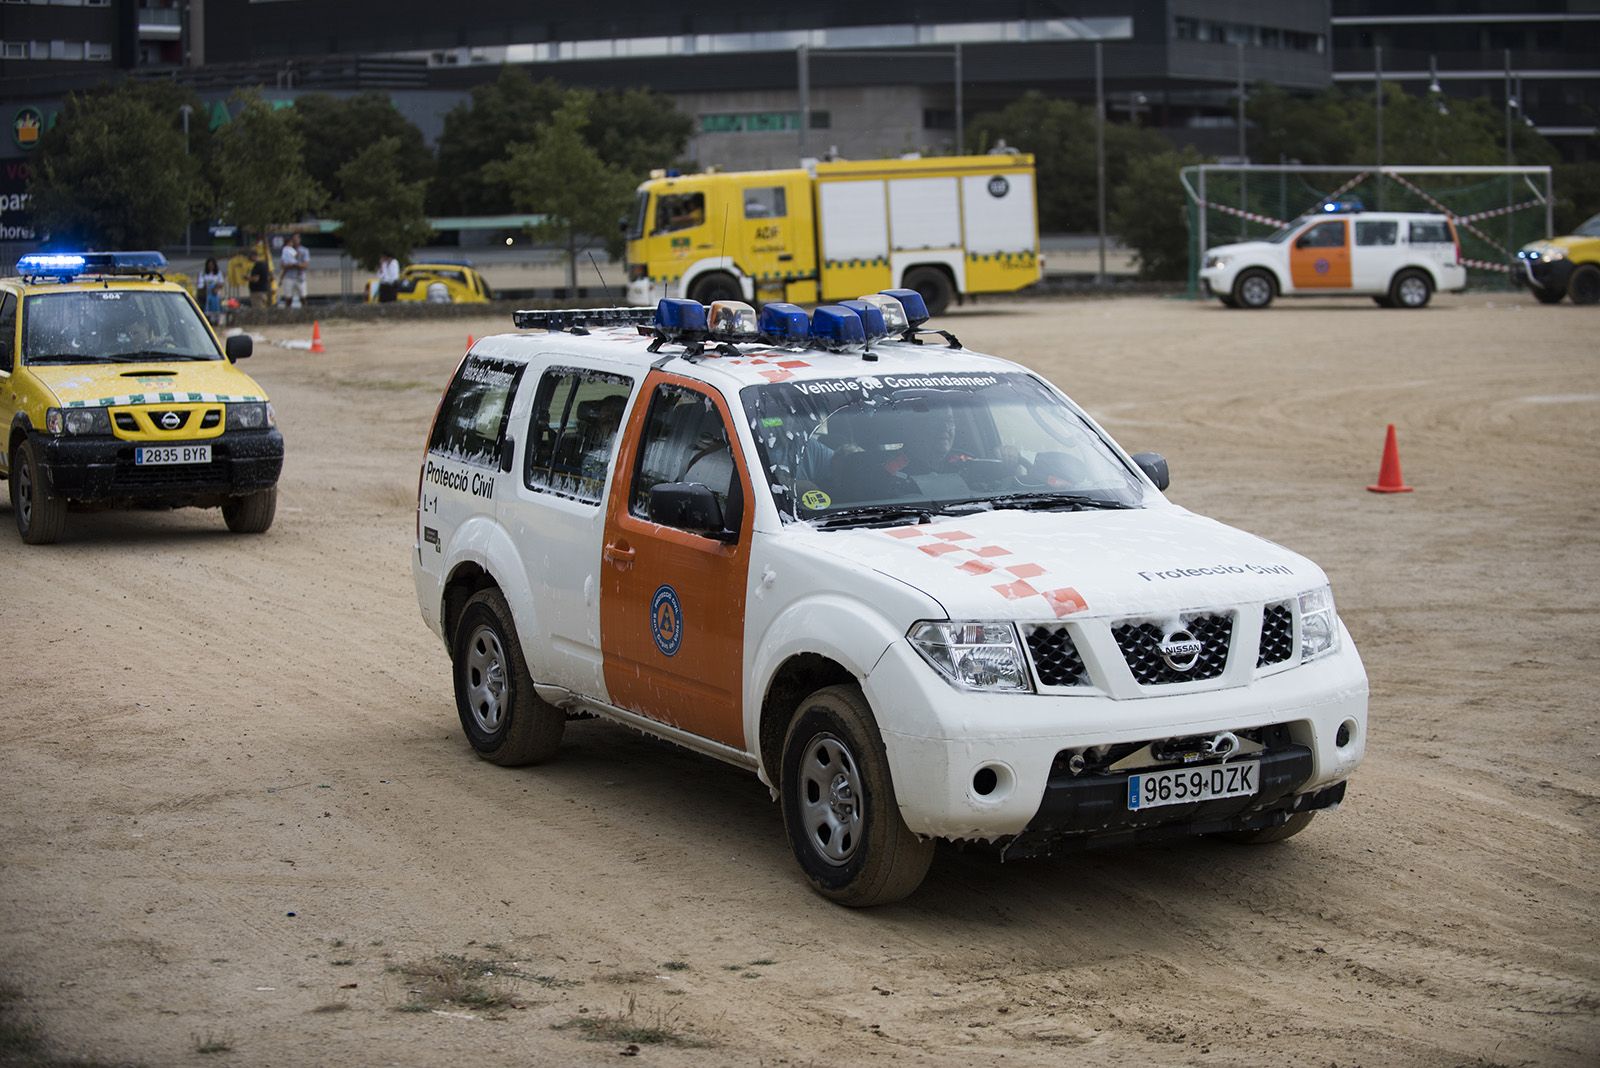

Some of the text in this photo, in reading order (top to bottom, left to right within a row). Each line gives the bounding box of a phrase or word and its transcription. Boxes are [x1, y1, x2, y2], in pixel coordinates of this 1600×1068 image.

[794, 380, 860, 397] Vehicle
[883, 375, 997, 389] Comandament
[145, 447, 207, 463] 2835 BYR
[426, 460, 495, 500] Protecció Civil
[1165, 644, 1200, 654] NISSAN
[1144, 771, 1202, 802] 9659
[1211, 765, 1254, 795] DZK
